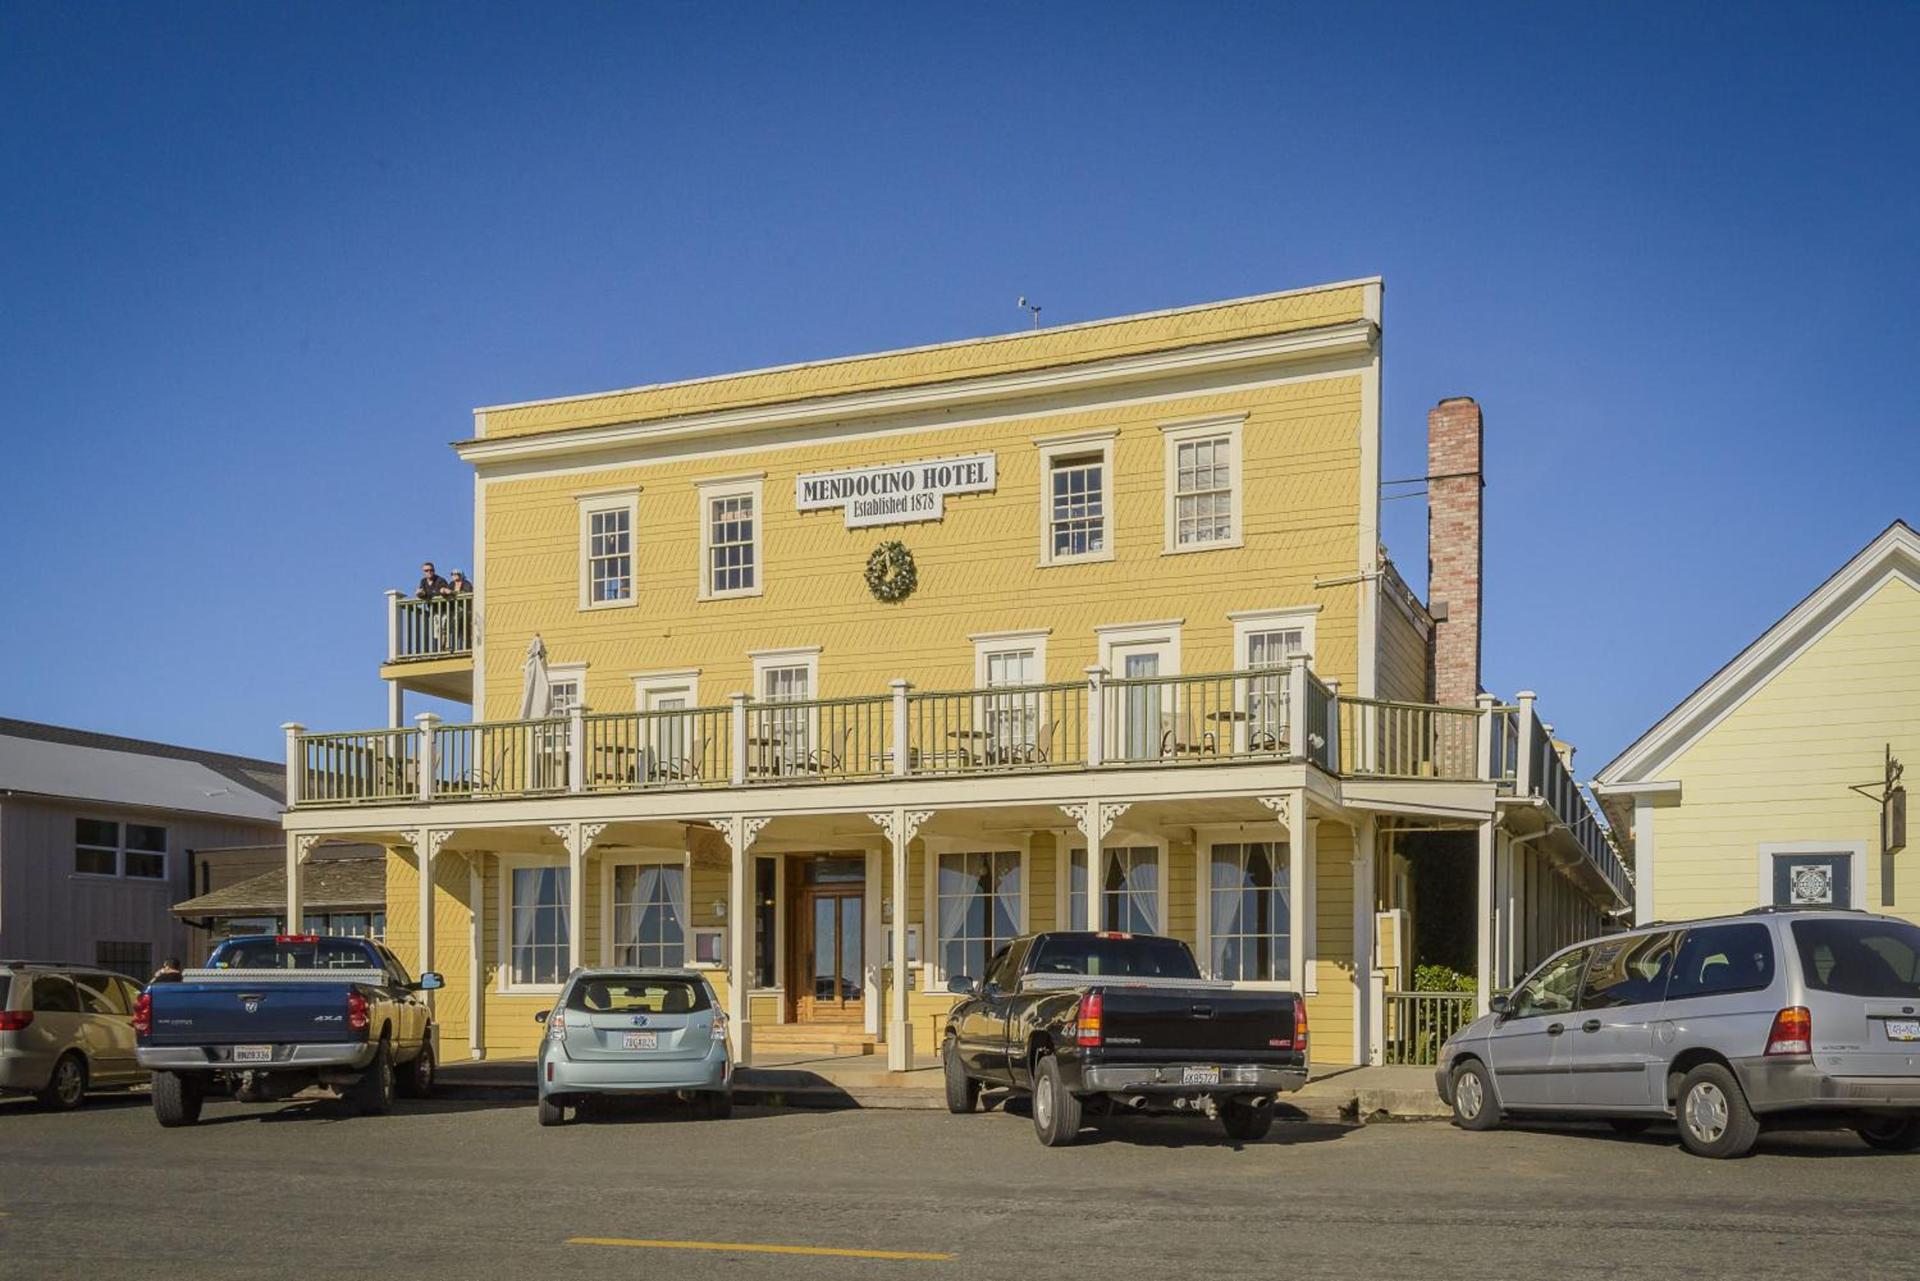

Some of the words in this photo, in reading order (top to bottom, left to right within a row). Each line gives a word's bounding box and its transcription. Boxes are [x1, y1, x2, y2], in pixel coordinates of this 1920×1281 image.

[803, 470, 915, 502] MENDOCINO
[923, 462, 988, 489] HOTEL
[854, 494, 908, 518] Established
[910, 492, 935, 512] 1878
